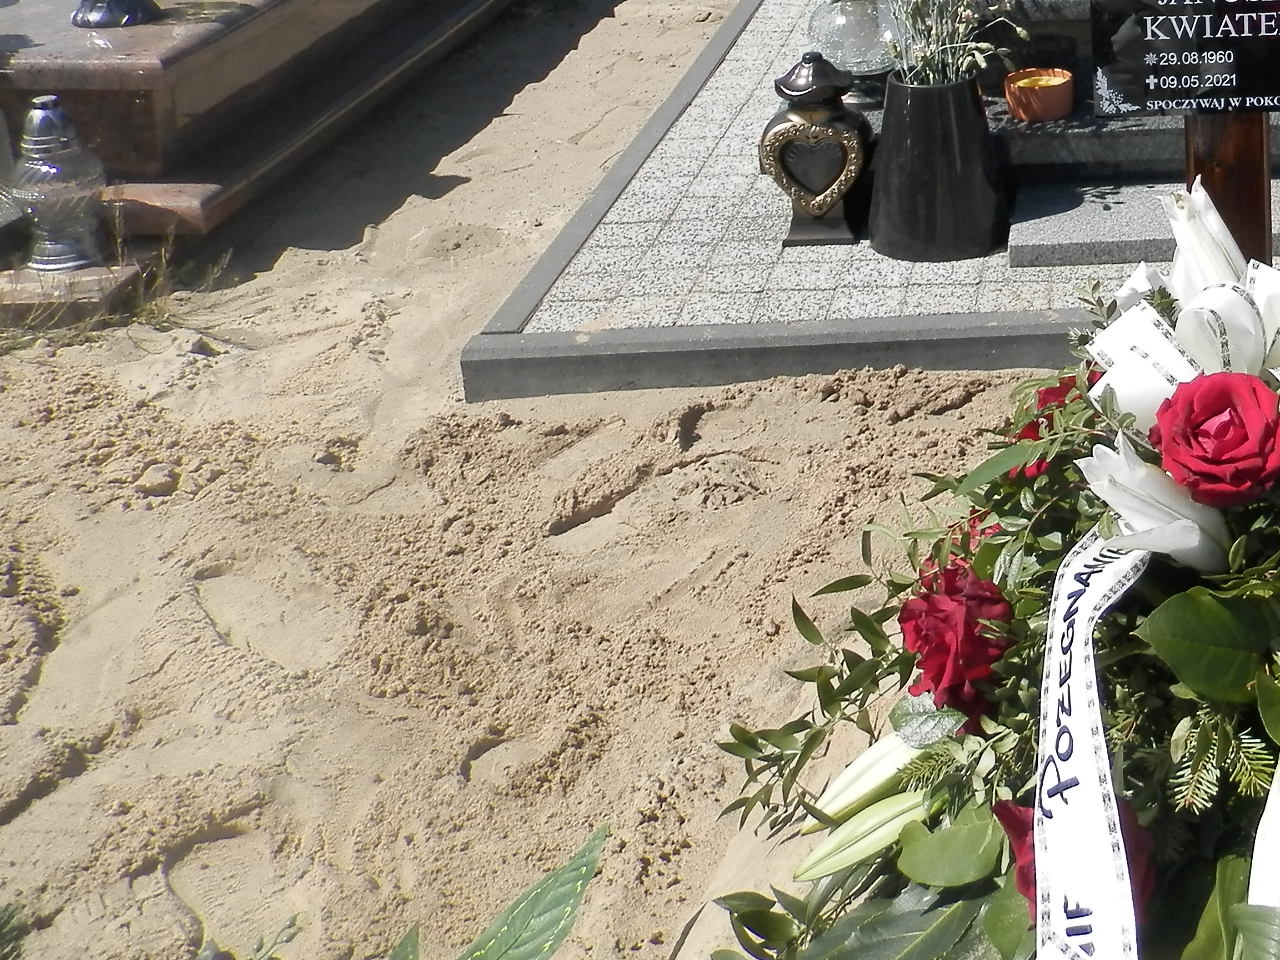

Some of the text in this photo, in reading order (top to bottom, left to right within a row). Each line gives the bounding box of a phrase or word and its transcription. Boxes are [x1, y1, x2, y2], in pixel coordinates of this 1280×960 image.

[1159, 50, 1234, 66] 29.08.1960
[1160, 73, 1237, 89] 09.05.2021
[1146, 97, 1225, 111] SPOCZYWAJ
[1230, 97, 1242, 108] W
